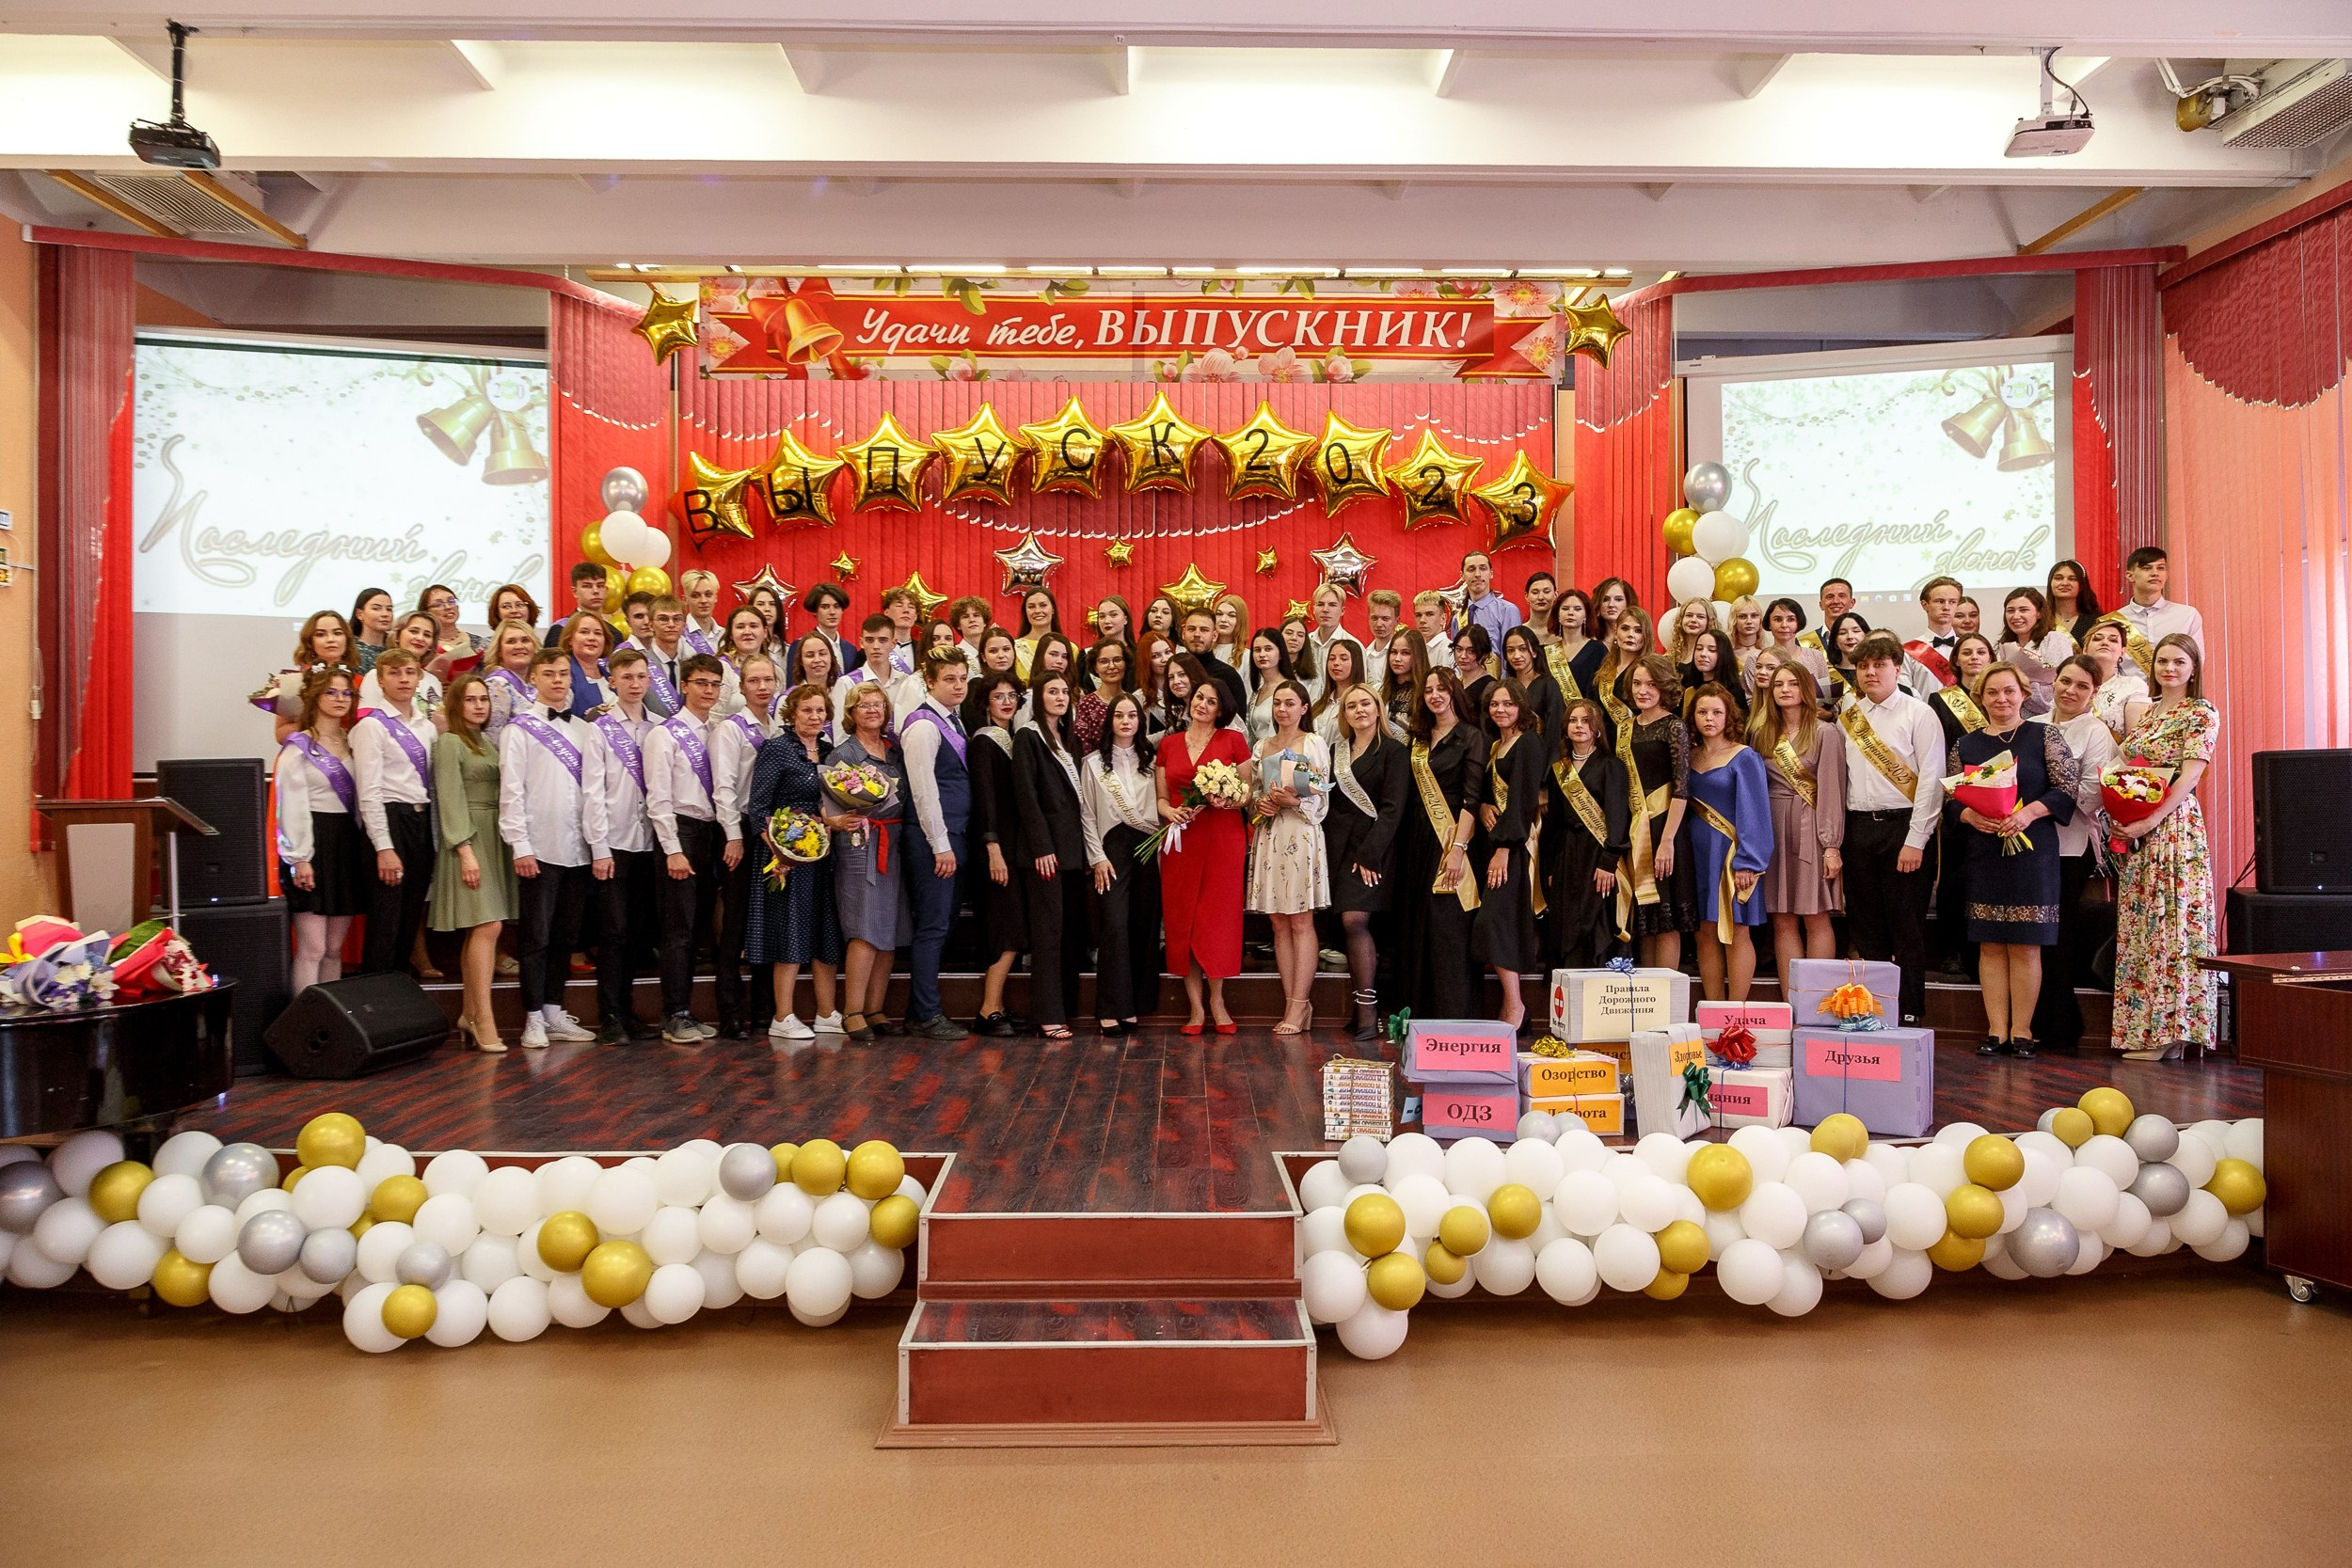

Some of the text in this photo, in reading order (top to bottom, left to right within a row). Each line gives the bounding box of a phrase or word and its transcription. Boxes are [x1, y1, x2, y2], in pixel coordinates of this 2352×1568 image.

[856, 307, 1473, 355] Удачи тебе, ВЫПУСКНИК!
[139, 434, 429, 608] Последний
[1744, 457, 1953, 581] Последний
[1912, 525, 2051, 593] звонок
[1606, 985, 1649, 993] Правила
[1599, 995, 1657, 1006] Дорожного
[1601, 1006, 1654, 1016] Движения
[1724, 1015, 1767, 1026] Удача
[1426, 1038, 1502, 1055] Энергия
[1675, 1050, 1703, 1063] Здоровье
[1825, 1050, 1881, 1066] Друзья
[1541, 1069, 1607, 1082] Озорство
[1707, 1092, 1752, 1105] нания
[1447, 1103, 1493, 1122] ОДЗ
